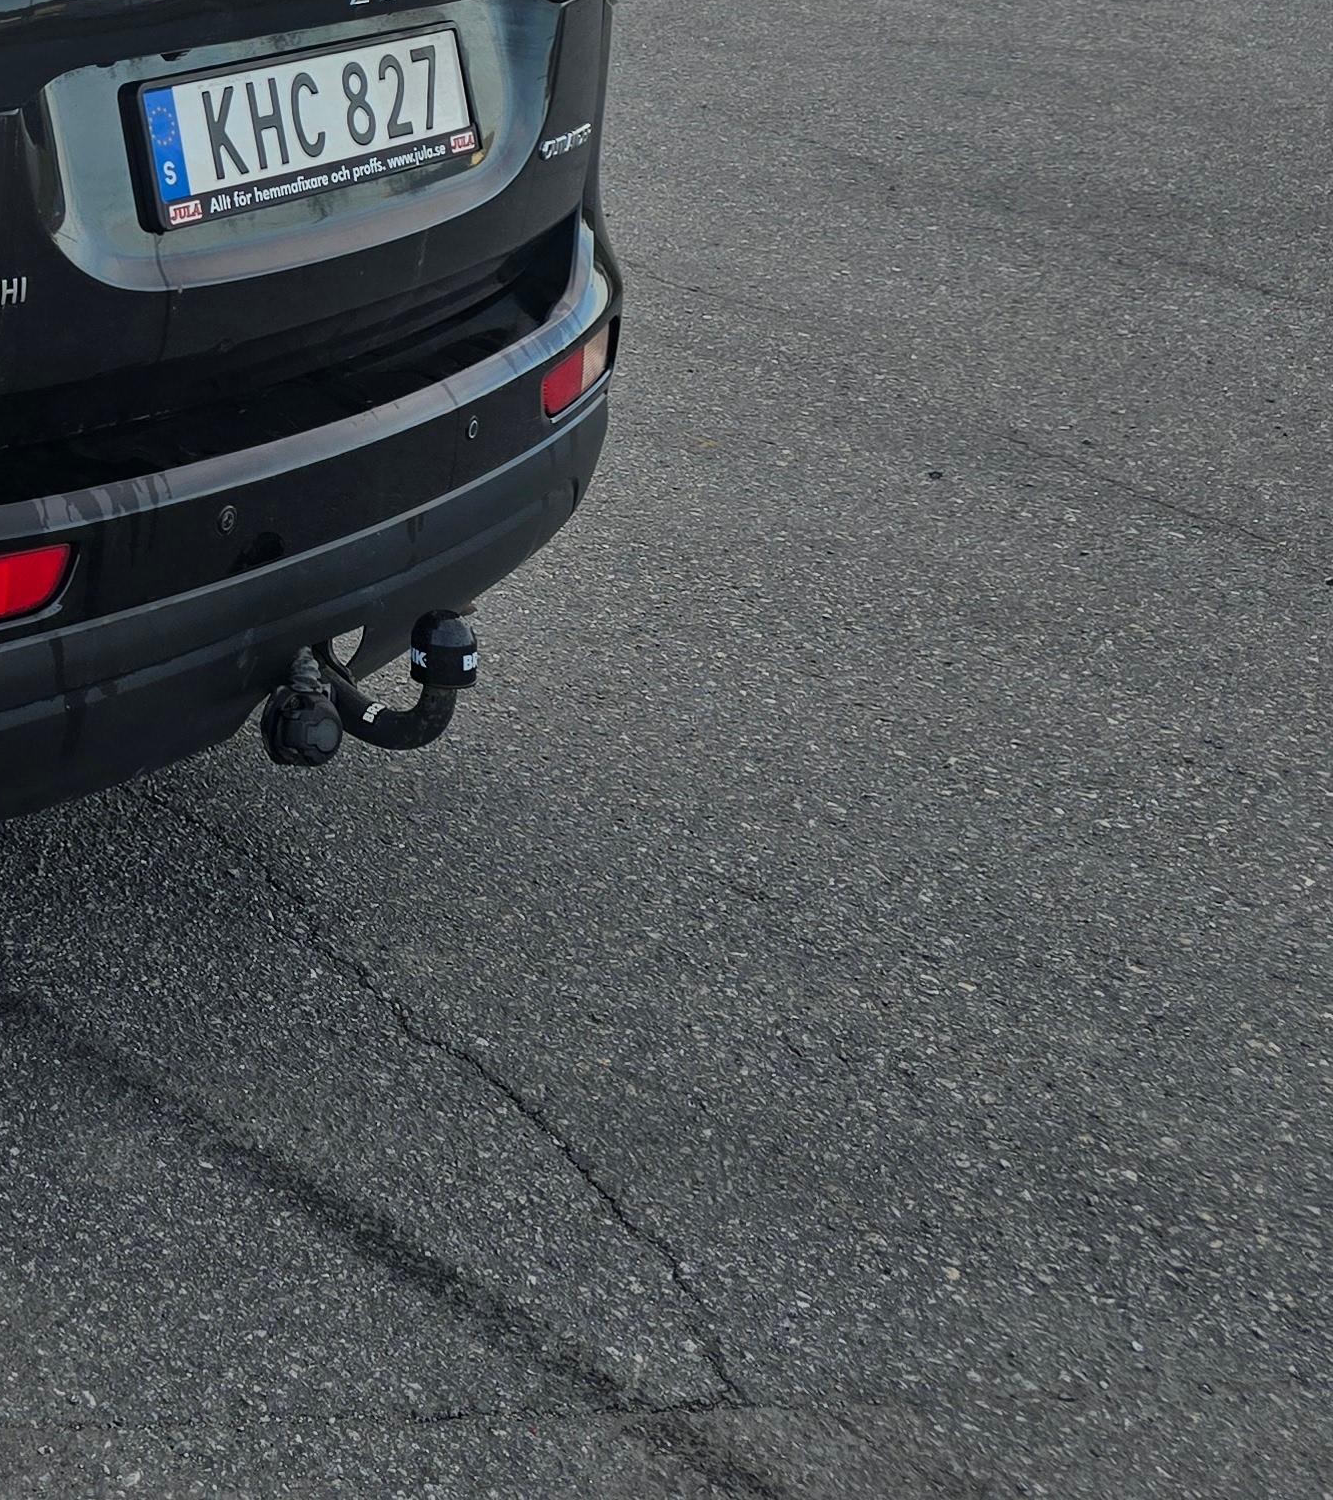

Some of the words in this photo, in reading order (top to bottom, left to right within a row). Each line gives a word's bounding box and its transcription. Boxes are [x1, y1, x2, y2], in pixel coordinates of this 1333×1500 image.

[201, 72, 326, 180] KHC
[341, 45, 436, 146] 827
[452, 133, 476, 150] JULA
[163, 161, 177, 185] S
[210, 194, 231, 213] Allt
[233, 191, 252, 208] för
[254, 174, 329, 202] hemmafixare
[331, 165, 350, 183] och
[353, 157, 386, 182] proffs.
[387, 143, 446, 169] www.jula.se
[170, 204, 202, 221] JULA
